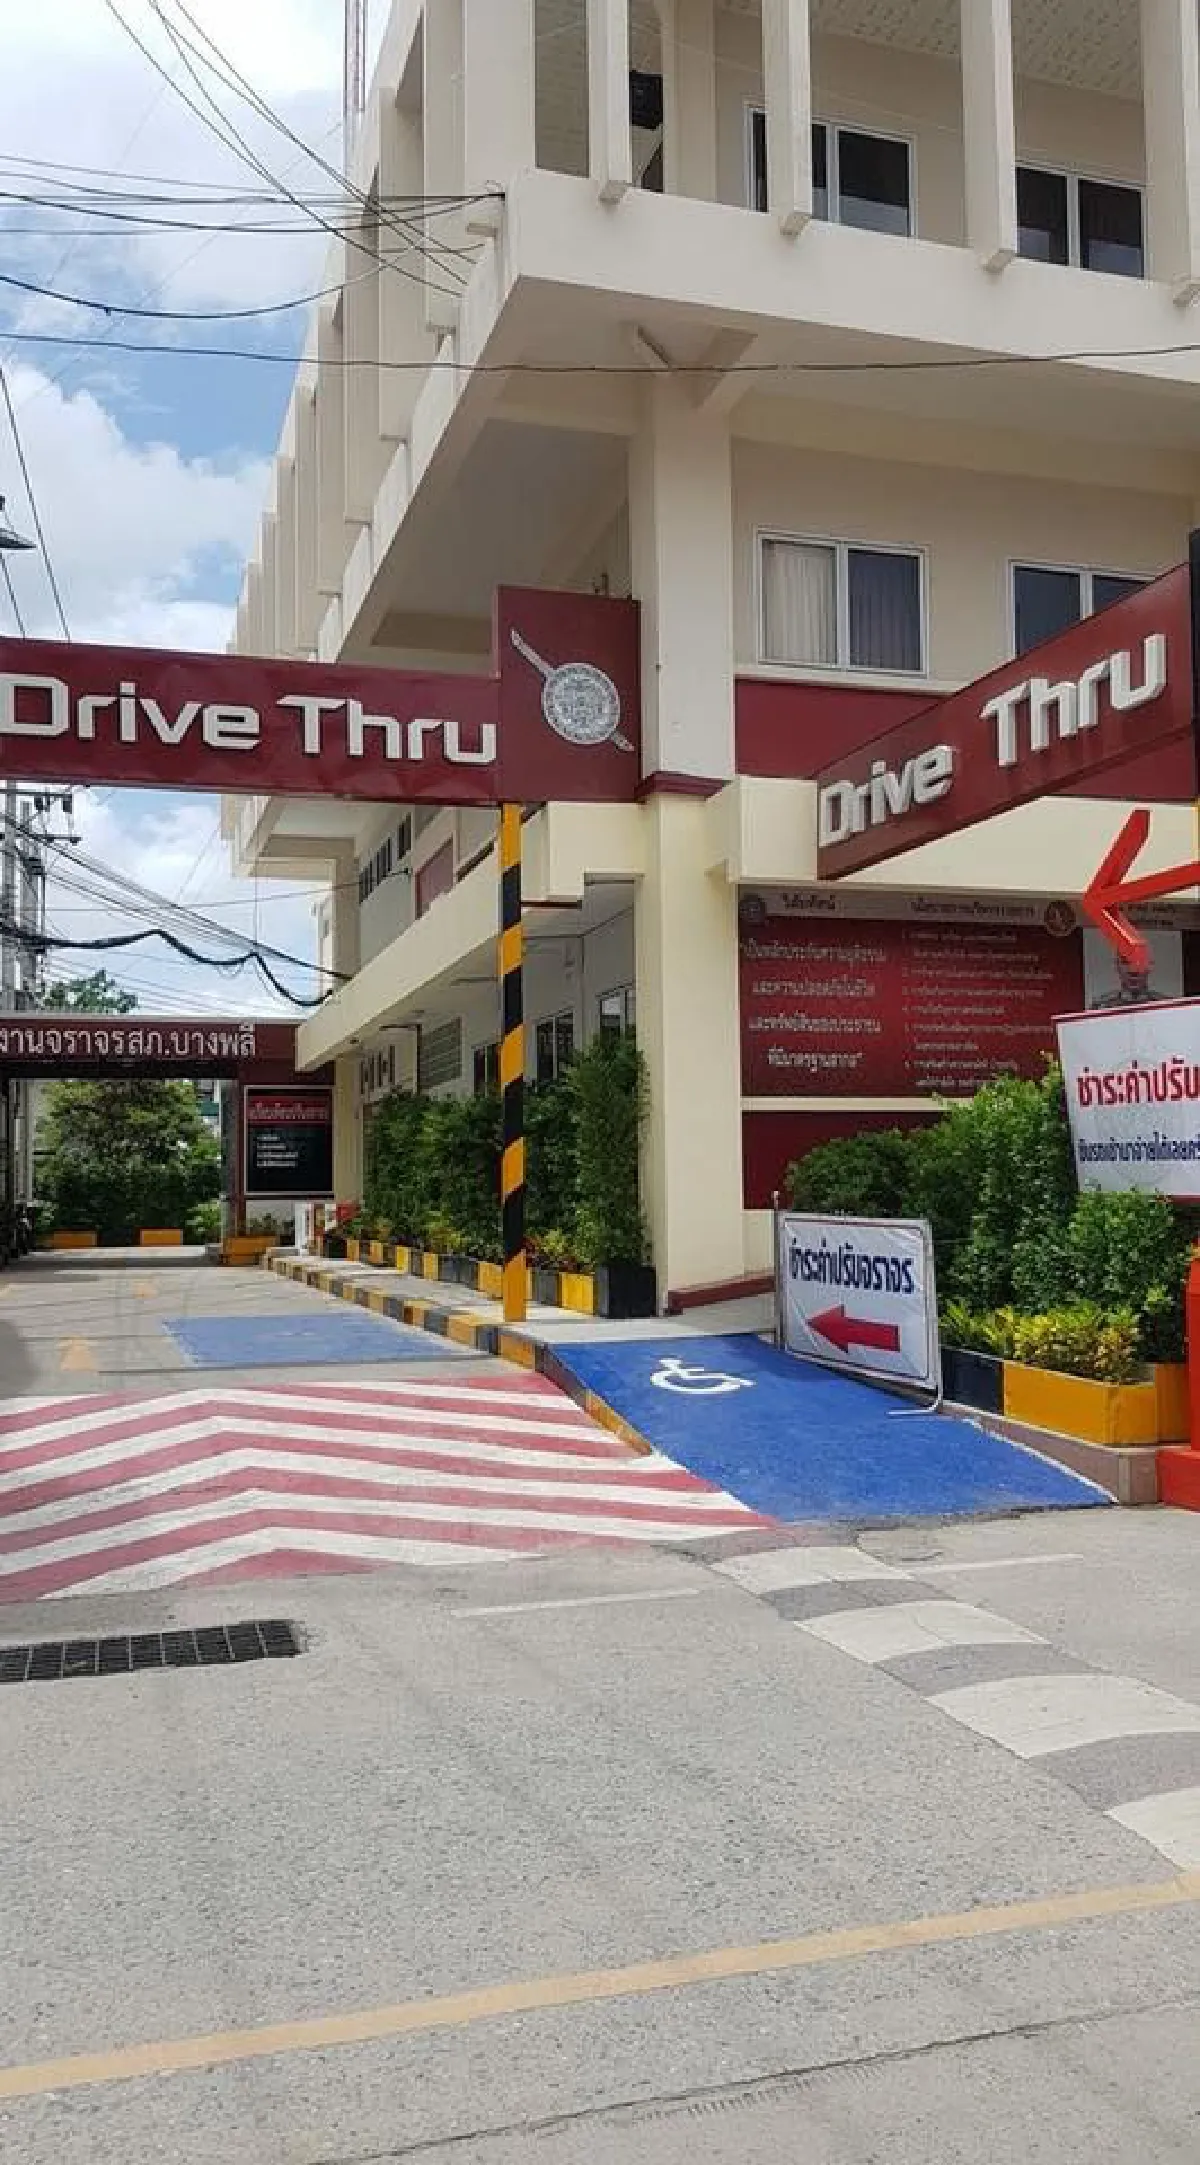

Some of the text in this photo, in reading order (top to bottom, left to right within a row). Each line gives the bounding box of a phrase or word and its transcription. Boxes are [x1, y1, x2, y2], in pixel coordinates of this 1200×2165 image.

[0, 672, 497, 764] Drive Thru
[819, 634, 1167, 847] Drive Thru
[789, 1237, 915, 1295] ชำระค่าปรับจราจร
